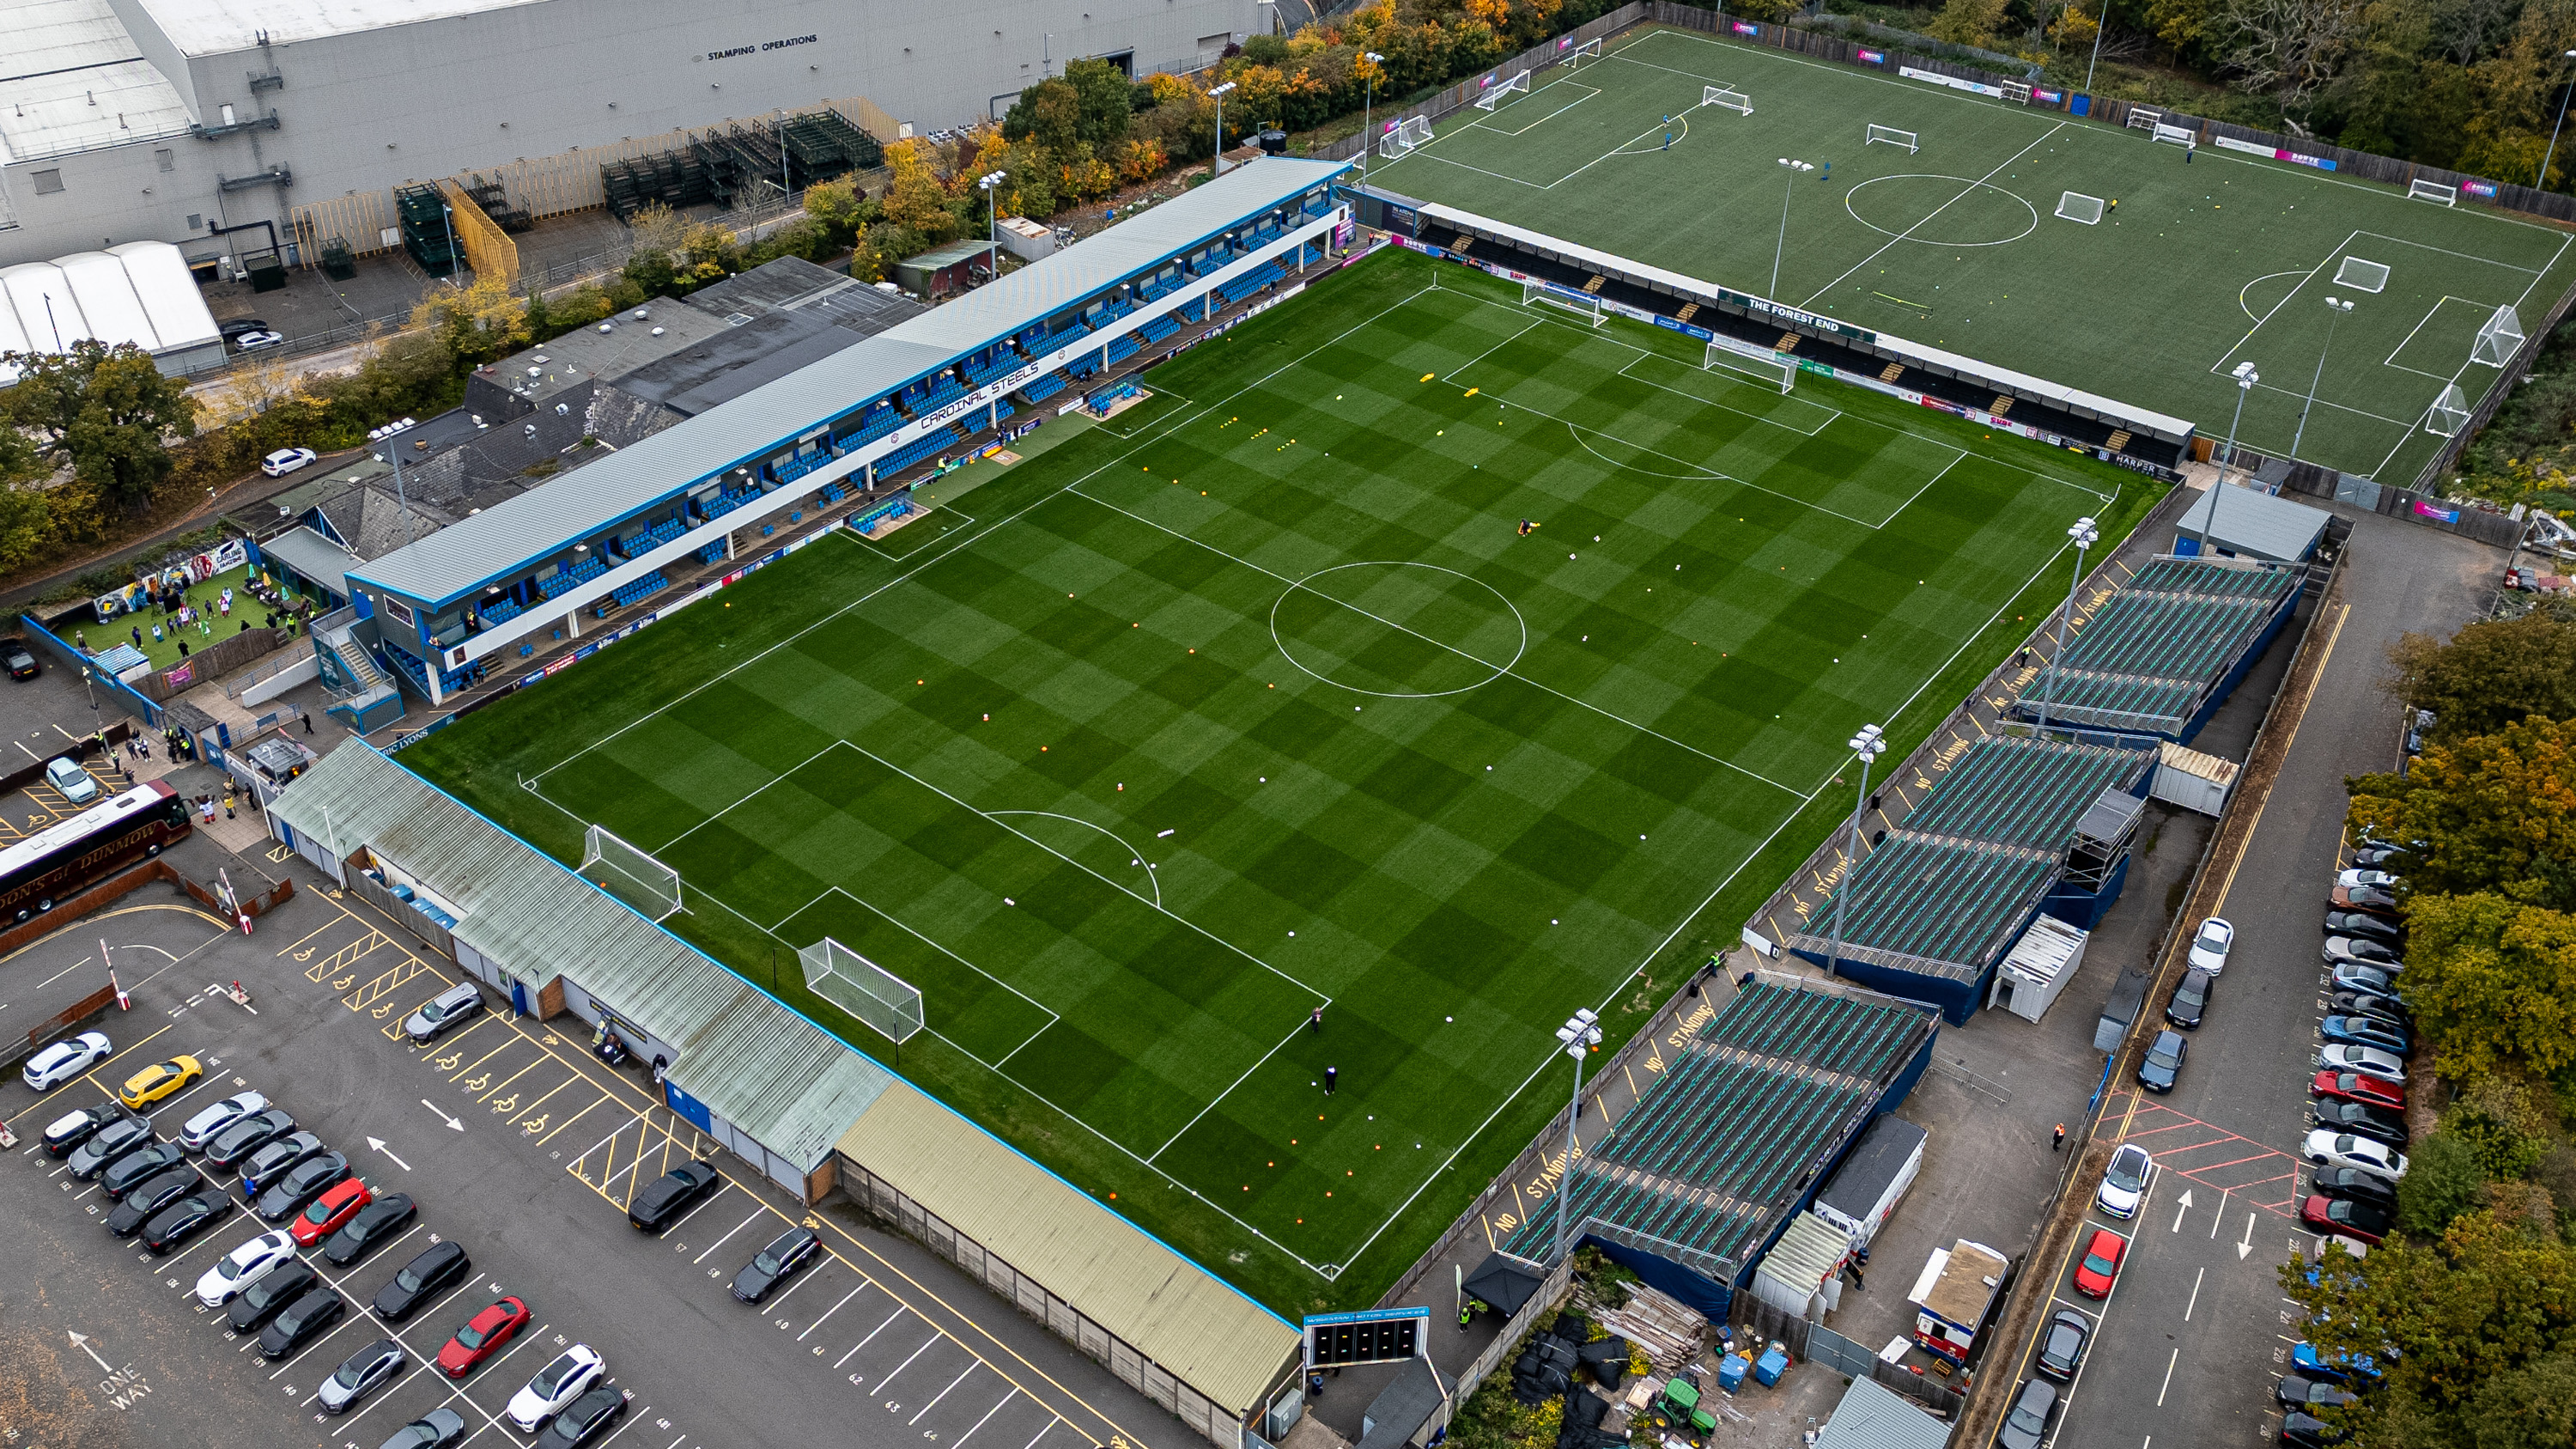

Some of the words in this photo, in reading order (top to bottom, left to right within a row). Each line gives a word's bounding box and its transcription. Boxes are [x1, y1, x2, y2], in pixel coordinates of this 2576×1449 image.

[708, 46, 756, 60] STAMPING
[762, 34, 817, 51] OPERATIONS
[1749, 299, 1770, 312] THE
[1771, 306, 1814, 325] FOREST
[1815, 319, 1838, 332] END
[921, 391, 987, 429] CARDINAL
[992, 362, 1038, 394] STEELS
[2117, 454, 2154, 472] HARPER
[216, 548, 241, 563] CARLING
[2084, 588, 2113, 613] STANDING
[2007, 666, 2039, 694] STANDING
[380, 744, 398, 758] RIC
[399, 728, 428, 749] LYONS
[1914, 776, 1932, 791] NO
[1932, 737, 1970, 771] STANDING
[81, 824, 157, 869] DUNMOW
[1643, 1056, 1664, 1074] NO
[1668, 1003, 1714, 1049] STANDING
[1494, 1213, 1518, 1234] NO
[674, 1242, 687, 1253] 57
[708, 1267, 720, 1278] 58
[194, 1304, 209, 1314] 137
[775, 1318, 789, 1330] 60
[554, 1334, 567, 1346] 192
[812, 1346, 824, 1356] 61
[2274, 1346, 2285, 1363] 220
[252, 1357, 266, 1368] 139
[100, 1363, 141, 1395] ONE
[848, 1373, 863, 1385] 62
[110, 1379, 153, 1410] WAY
[283, 1384, 297, 1396] 140
[622, 1389, 635, 1401] 190
[884, 1401, 901, 1413] 63
[313, 1413, 328, 1424] 141
